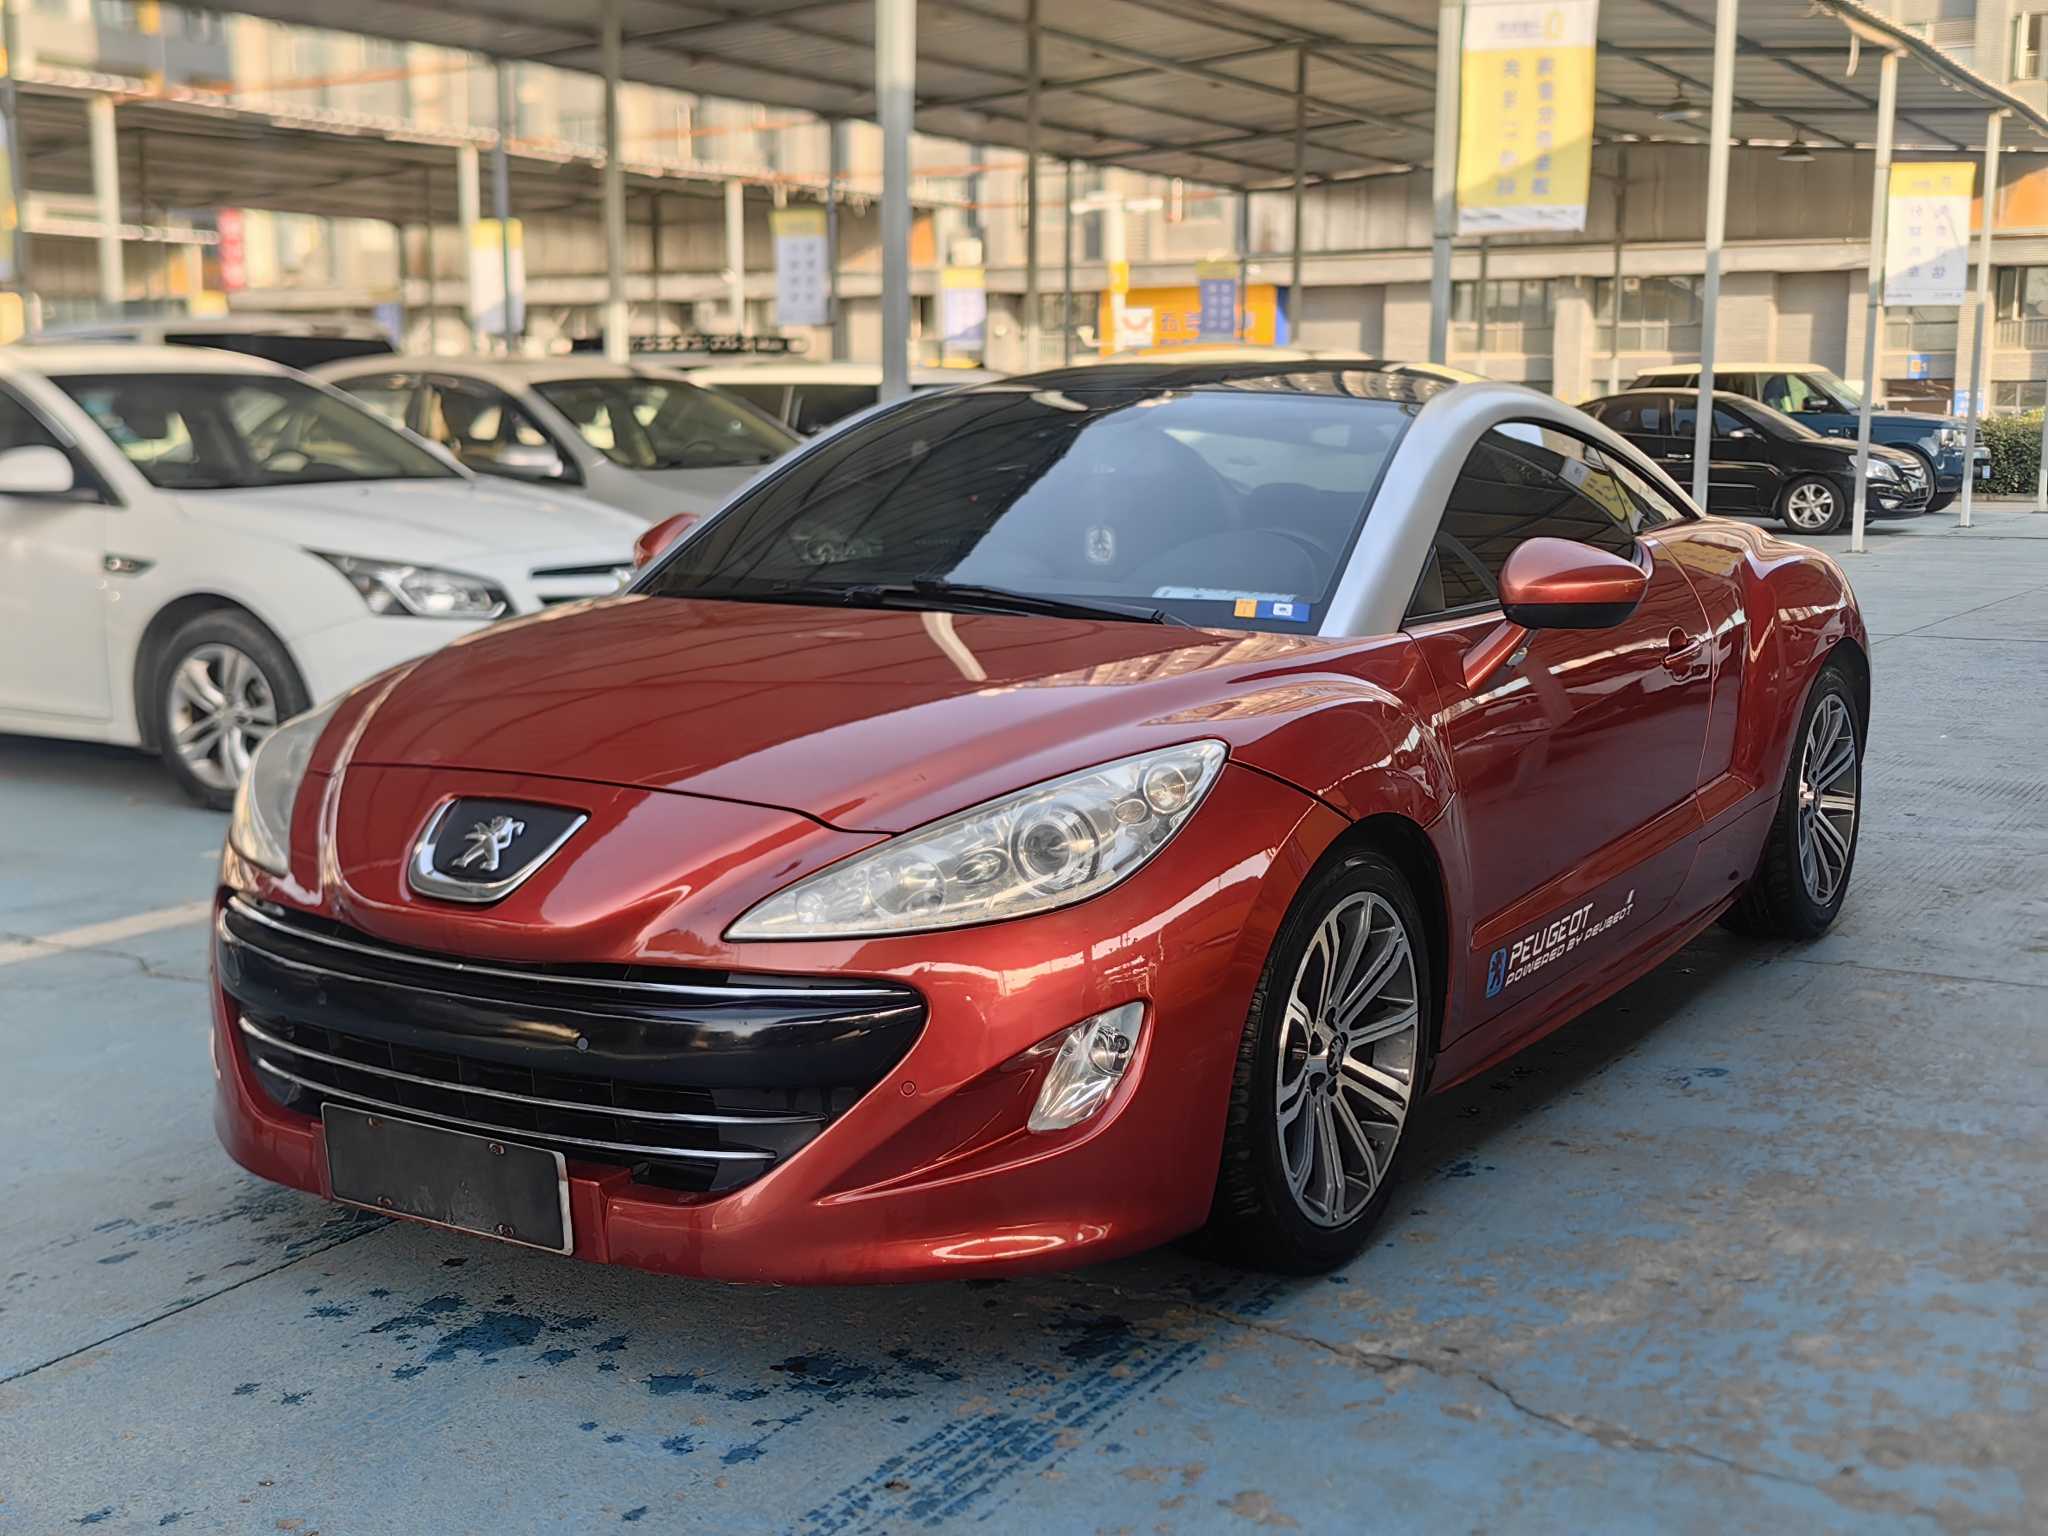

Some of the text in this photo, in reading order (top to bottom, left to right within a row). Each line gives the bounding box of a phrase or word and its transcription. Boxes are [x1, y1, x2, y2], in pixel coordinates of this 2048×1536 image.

[1504, 903, 1634, 988] POWERED BY PEUGEOT
[1508, 902, 1594, 970] PEUGEOT
